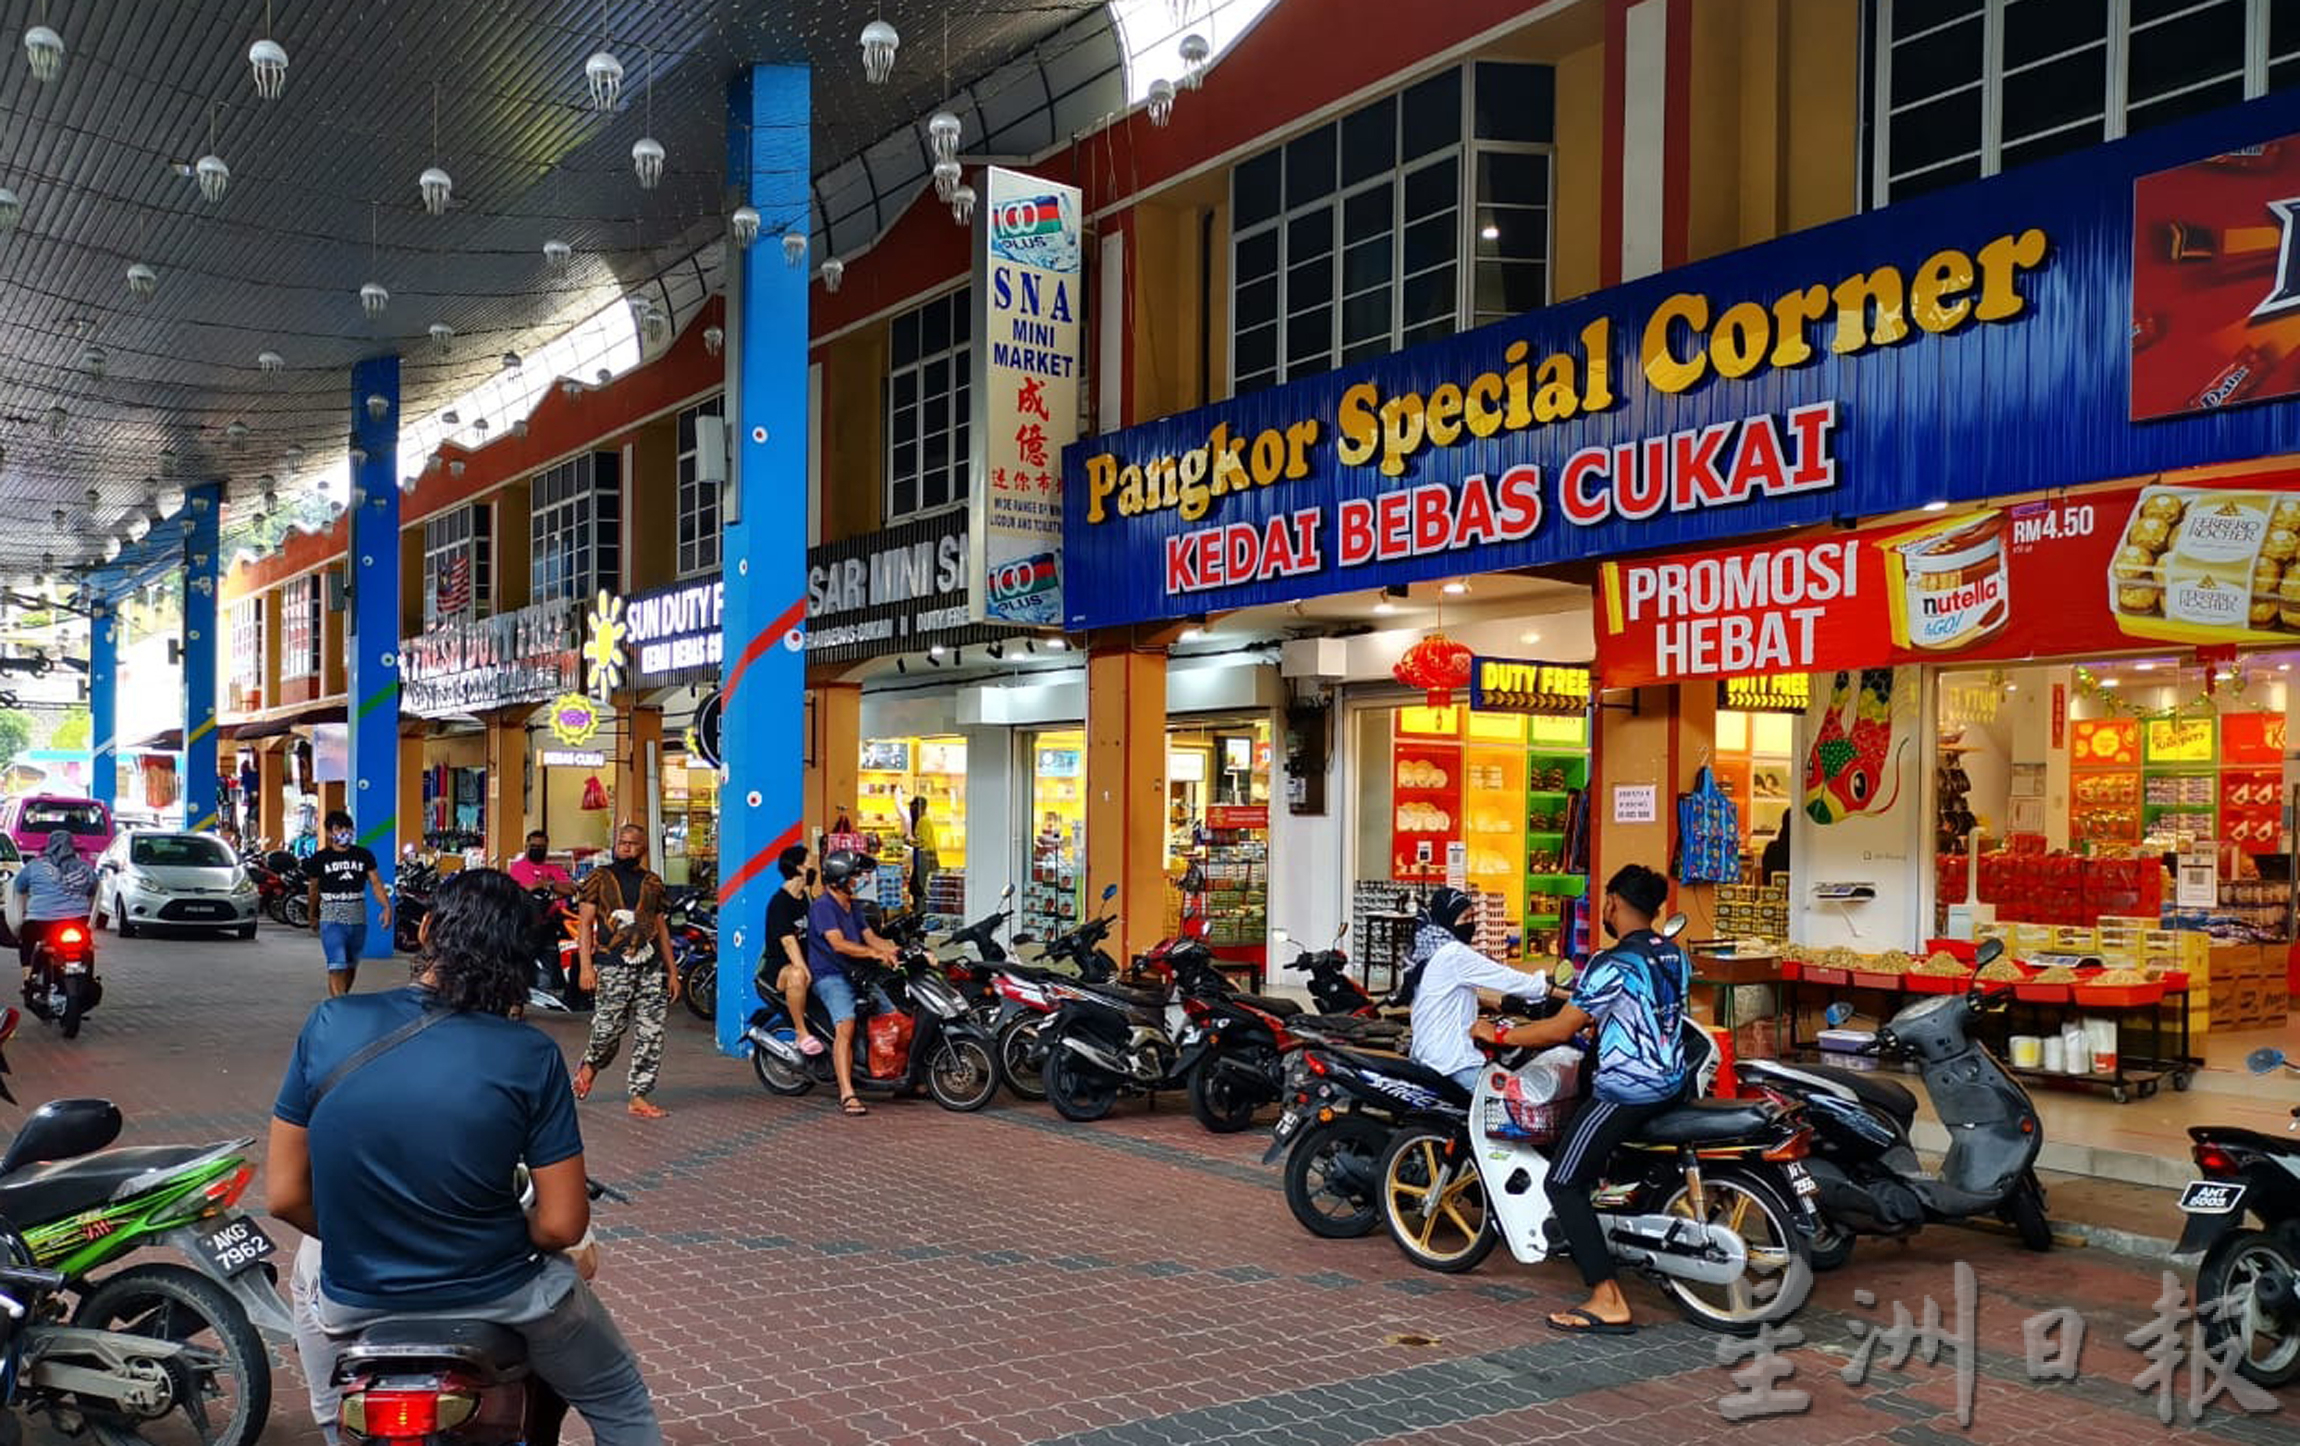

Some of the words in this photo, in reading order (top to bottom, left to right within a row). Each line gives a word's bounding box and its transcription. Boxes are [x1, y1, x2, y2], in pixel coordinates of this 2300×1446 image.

[988, 200, 1038, 237] 100
[1002, 236, 1048, 249] PLUS
[994, 266, 1073, 323] SNA
[1013, 318, 1055, 348] MINI
[994, 342, 1073, 377] MARKET
[1086, 420, 1318, 523] Pangkor
[1338, 317, 1613, 477] Special
[1642, 228, 2047, 394] Corner
[1014, 376, 1050, 468] 成億
[1166, 506, 1321, 594] KEDAI
[1338, 465, 1542, 567] BEBAS
[1558, 401, 1836, 527] CUKAI
[2013, 505, 2094, 545] RM4.50
[808, 557, 868, 618] SAR
[870, 541, 935, 605] MINI
[987, 562, 1035, 601] 100
[1628, 540, 1860, 621] PROMOSI
[1923, 579, 1998, 615] nutella
[626, 596, 661, 644] SUN
[661, 584, 712, 636] DUTY
[916, 609, 944, 632] DUTY
[998, 595, 1044, 612] PLUS
[1656, 606, 1826, 677] HEBAT
[1481, 662, 1537, 693] DUTY
[1541, 667, 1590, 697] FREE
[213, 1223, 249, 1251] AKG
[214, 1236, 270, 1271] 7962
